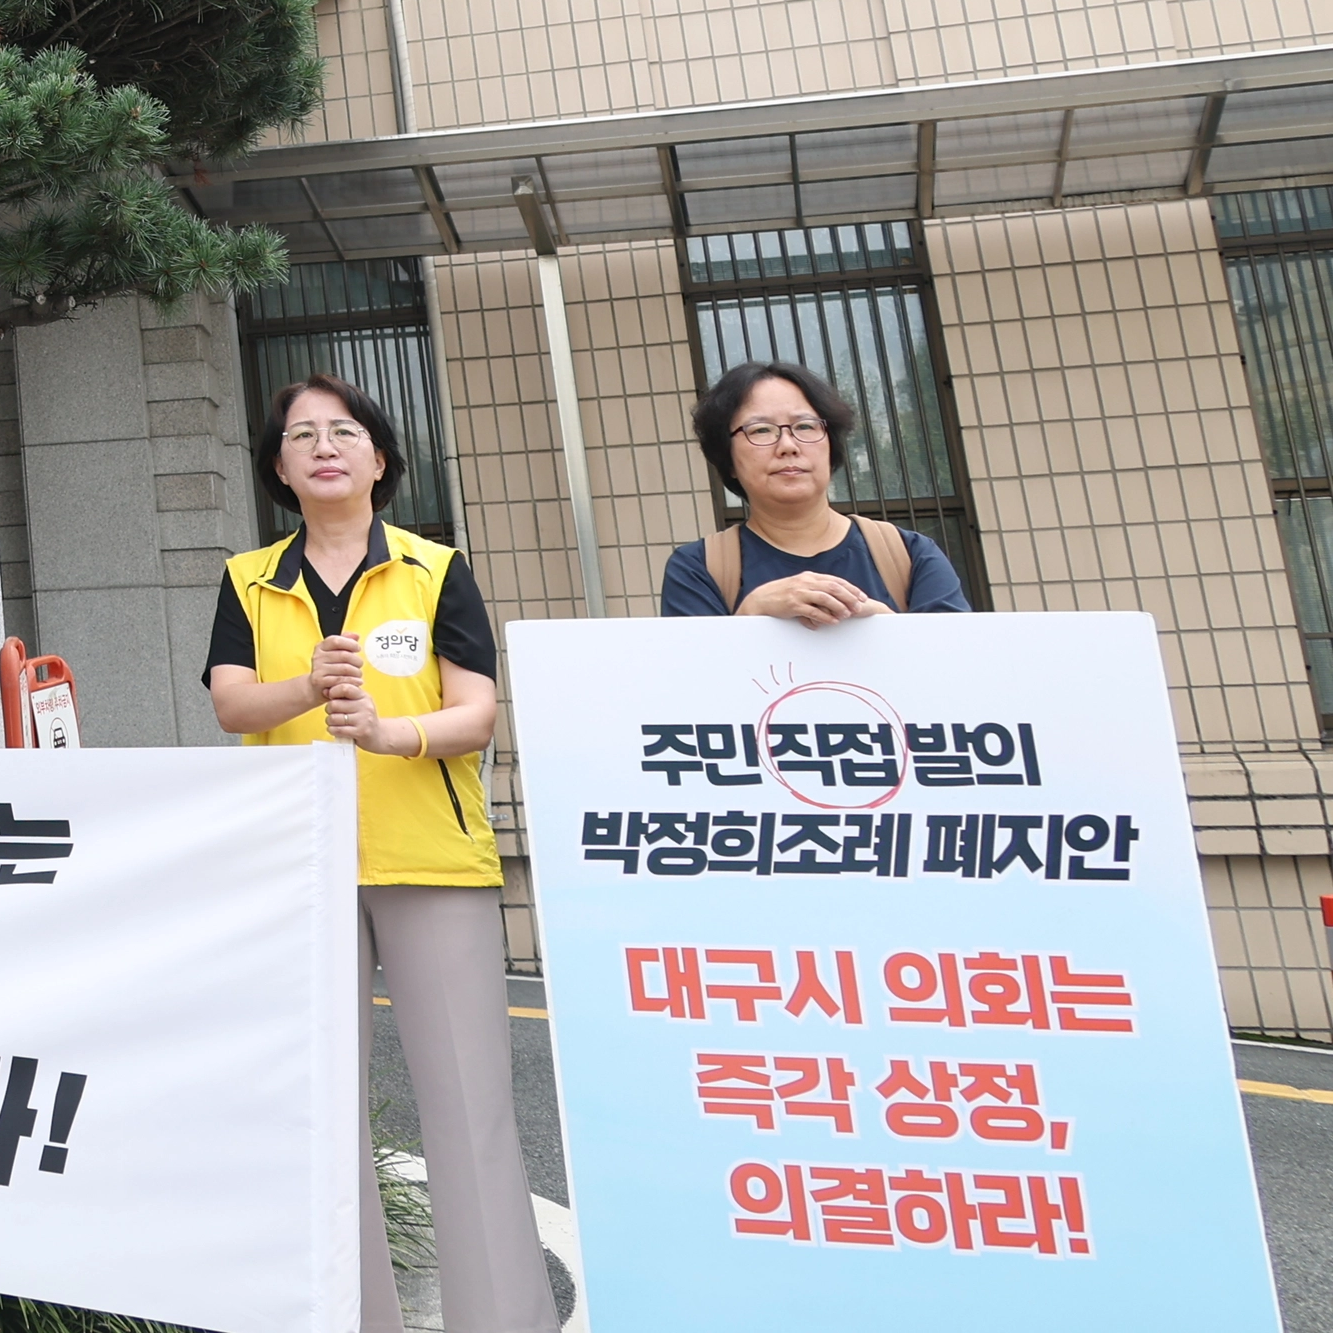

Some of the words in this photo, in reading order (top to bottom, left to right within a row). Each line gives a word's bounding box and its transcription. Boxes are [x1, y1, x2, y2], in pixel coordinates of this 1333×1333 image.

[375, 634, 419, 652] 정의당
[641, 724, 762, 786] 주민
[768, 723, 900, 787] 직접
[906, 723, 1041, 786] 발의
[582, 811, 912, 877] 박정희조례
[923, 814, 1139, 880] 폐지안
[626, 948, 862, 1024] 대구시
[884, 952, 1132, 1032] 의회는
[696, 1054, 855, 1133] 즉각
[876, 1060, 1068, 1149] 상정,
[730, 1163, 1089, 1254] 의결하라!
